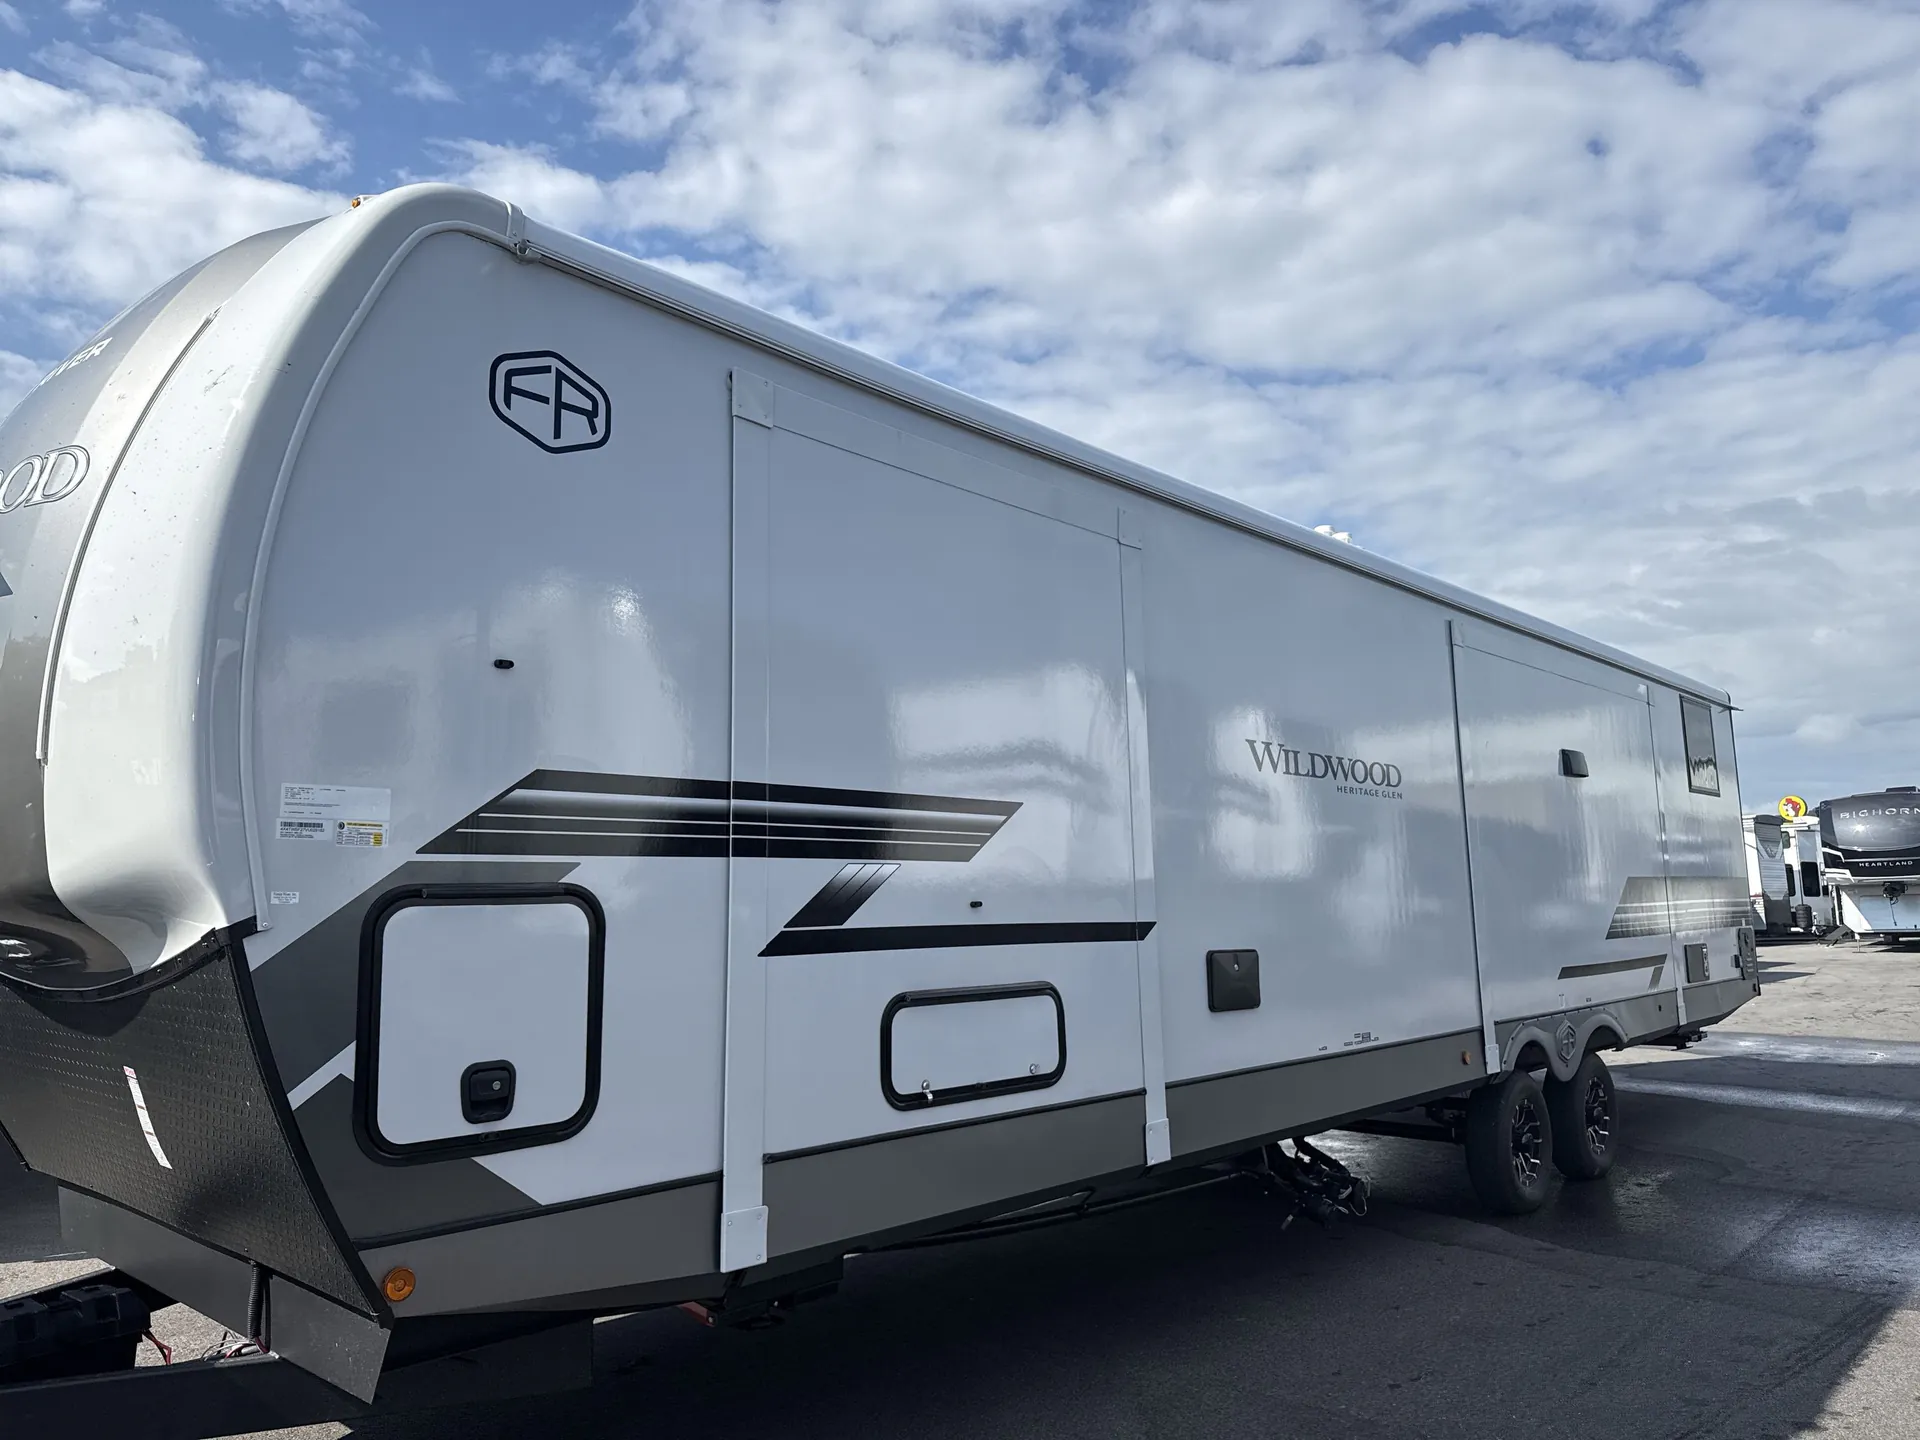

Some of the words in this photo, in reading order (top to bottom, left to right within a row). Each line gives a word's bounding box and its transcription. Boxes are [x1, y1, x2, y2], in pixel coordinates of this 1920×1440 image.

[503, 364, 599, 440] FR
[0, 445, 91, 514] OD
[1245, 738, 1402, 788] WILDWOOD
[1336, 785, 1380, 798] HERITAGE
[1381, 790, 1403, 800] GLEN
